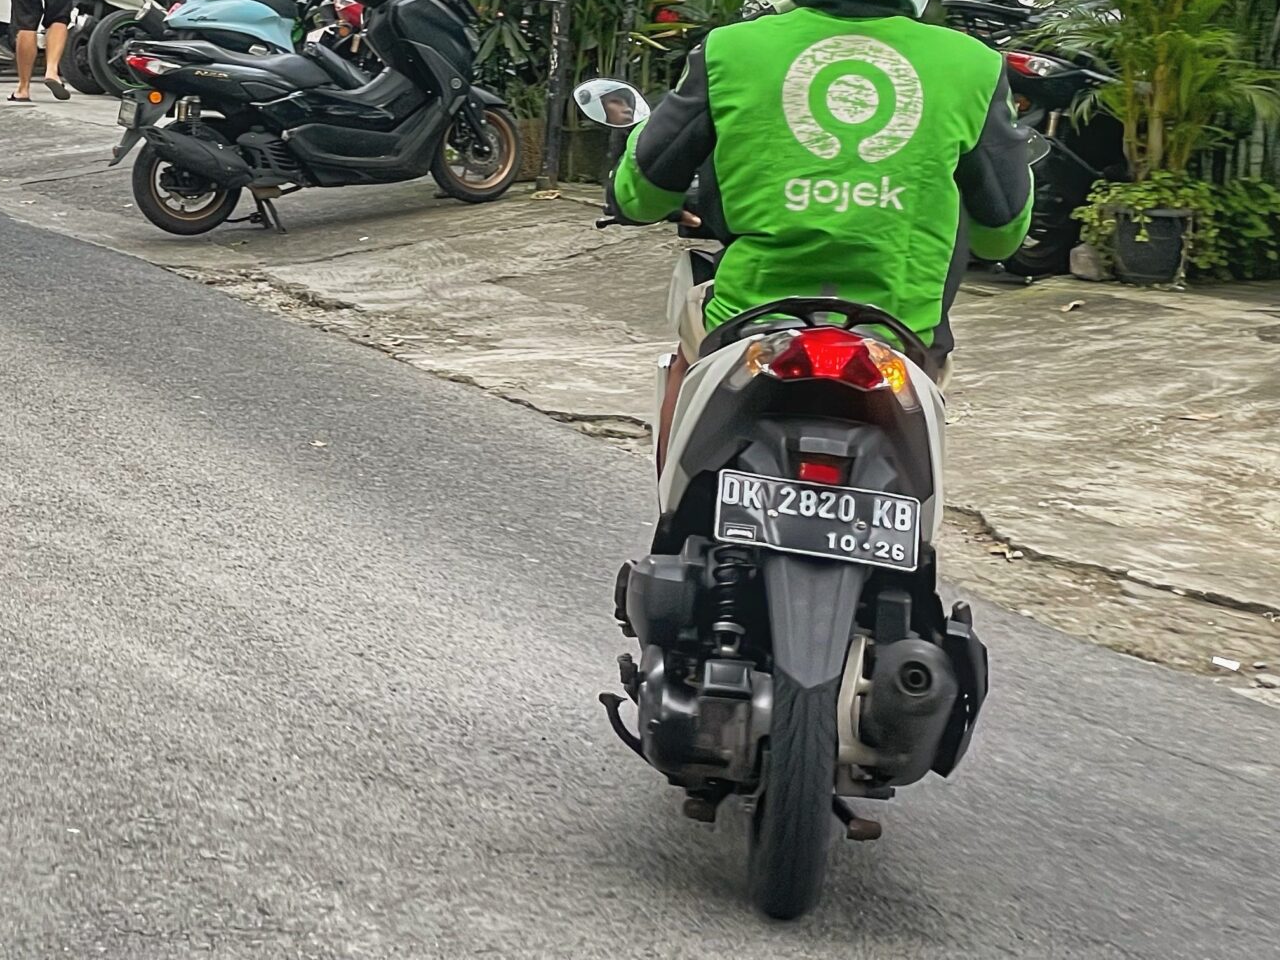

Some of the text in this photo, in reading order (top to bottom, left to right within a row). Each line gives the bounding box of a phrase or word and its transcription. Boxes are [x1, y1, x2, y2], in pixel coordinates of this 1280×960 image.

[784, 176, 907, 212] gojek
[722, 476, 912, 531] DK 2820 KB
